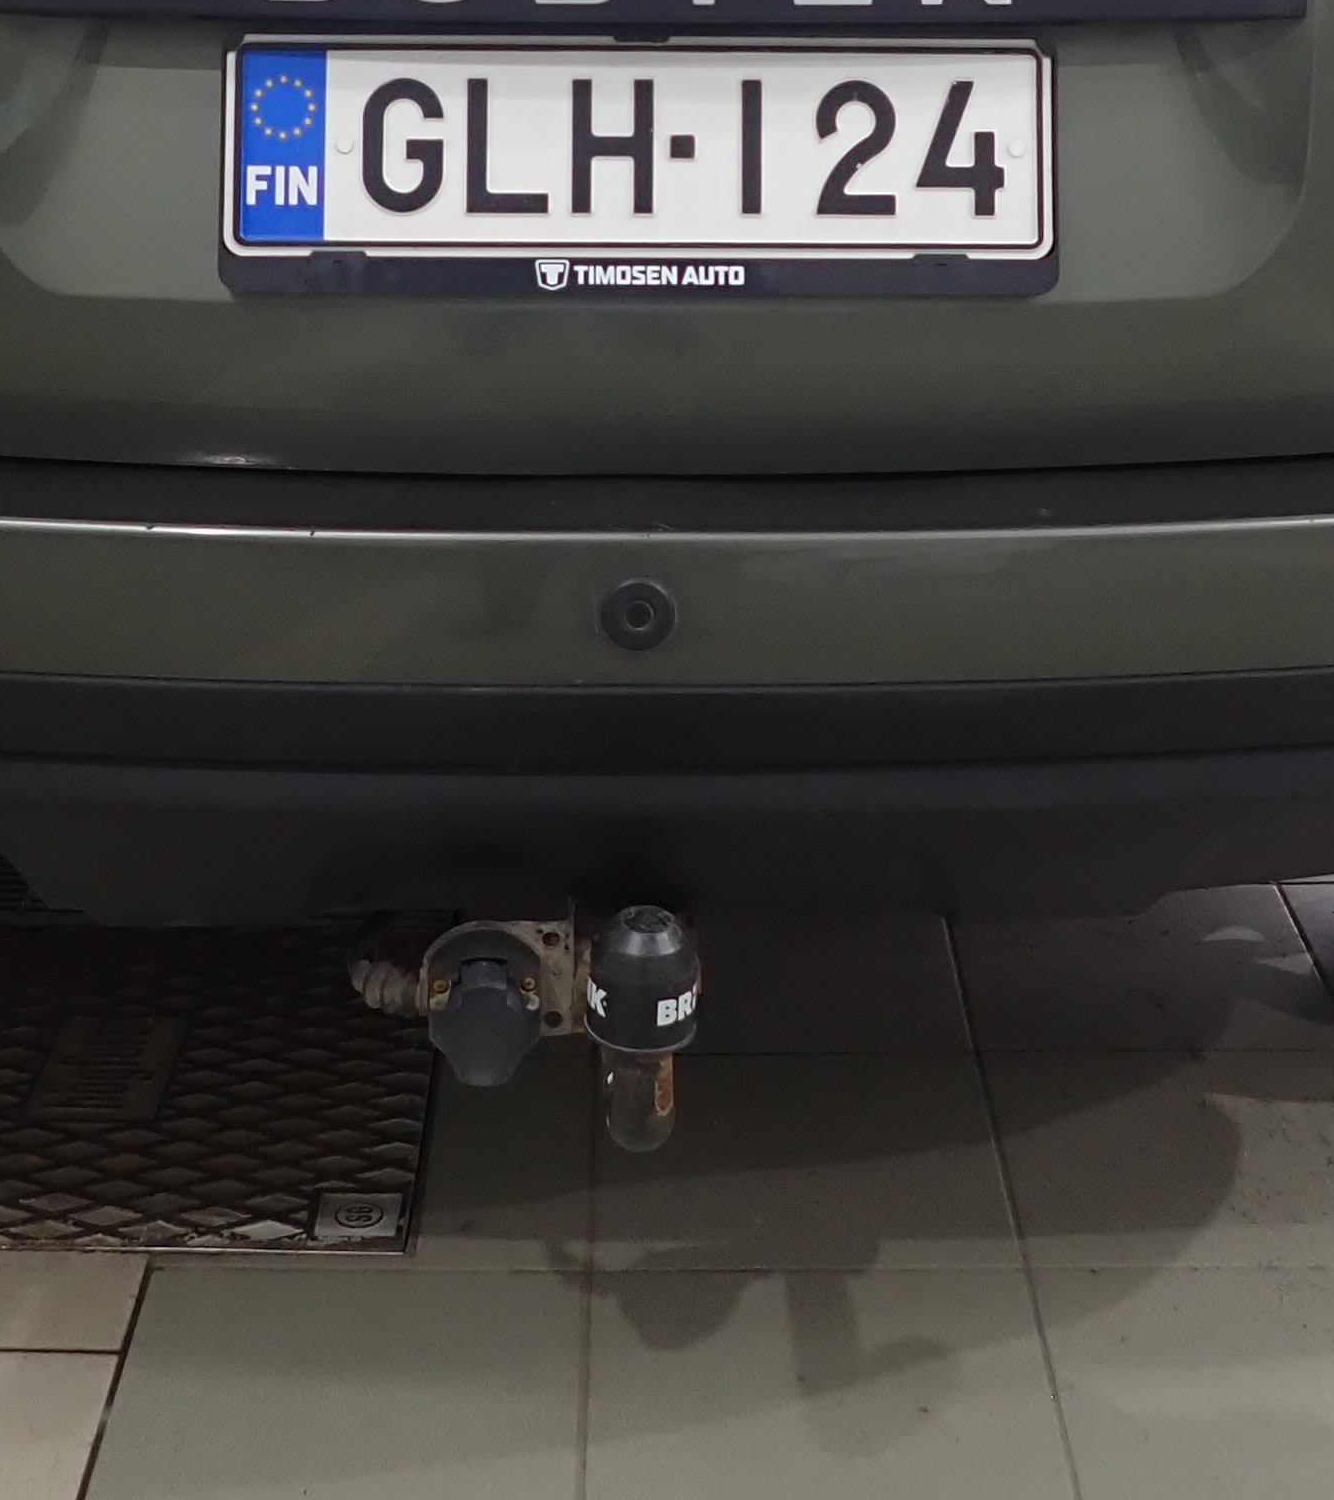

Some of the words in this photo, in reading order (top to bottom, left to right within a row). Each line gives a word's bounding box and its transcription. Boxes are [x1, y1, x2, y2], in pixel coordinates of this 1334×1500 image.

[360, 77, 1007, 218] GLH-124
[246, 165, 318, 206] FIN
[574, 265, 678, 286] TIMOSEN
[682, 265, 746, 286] AUTO
